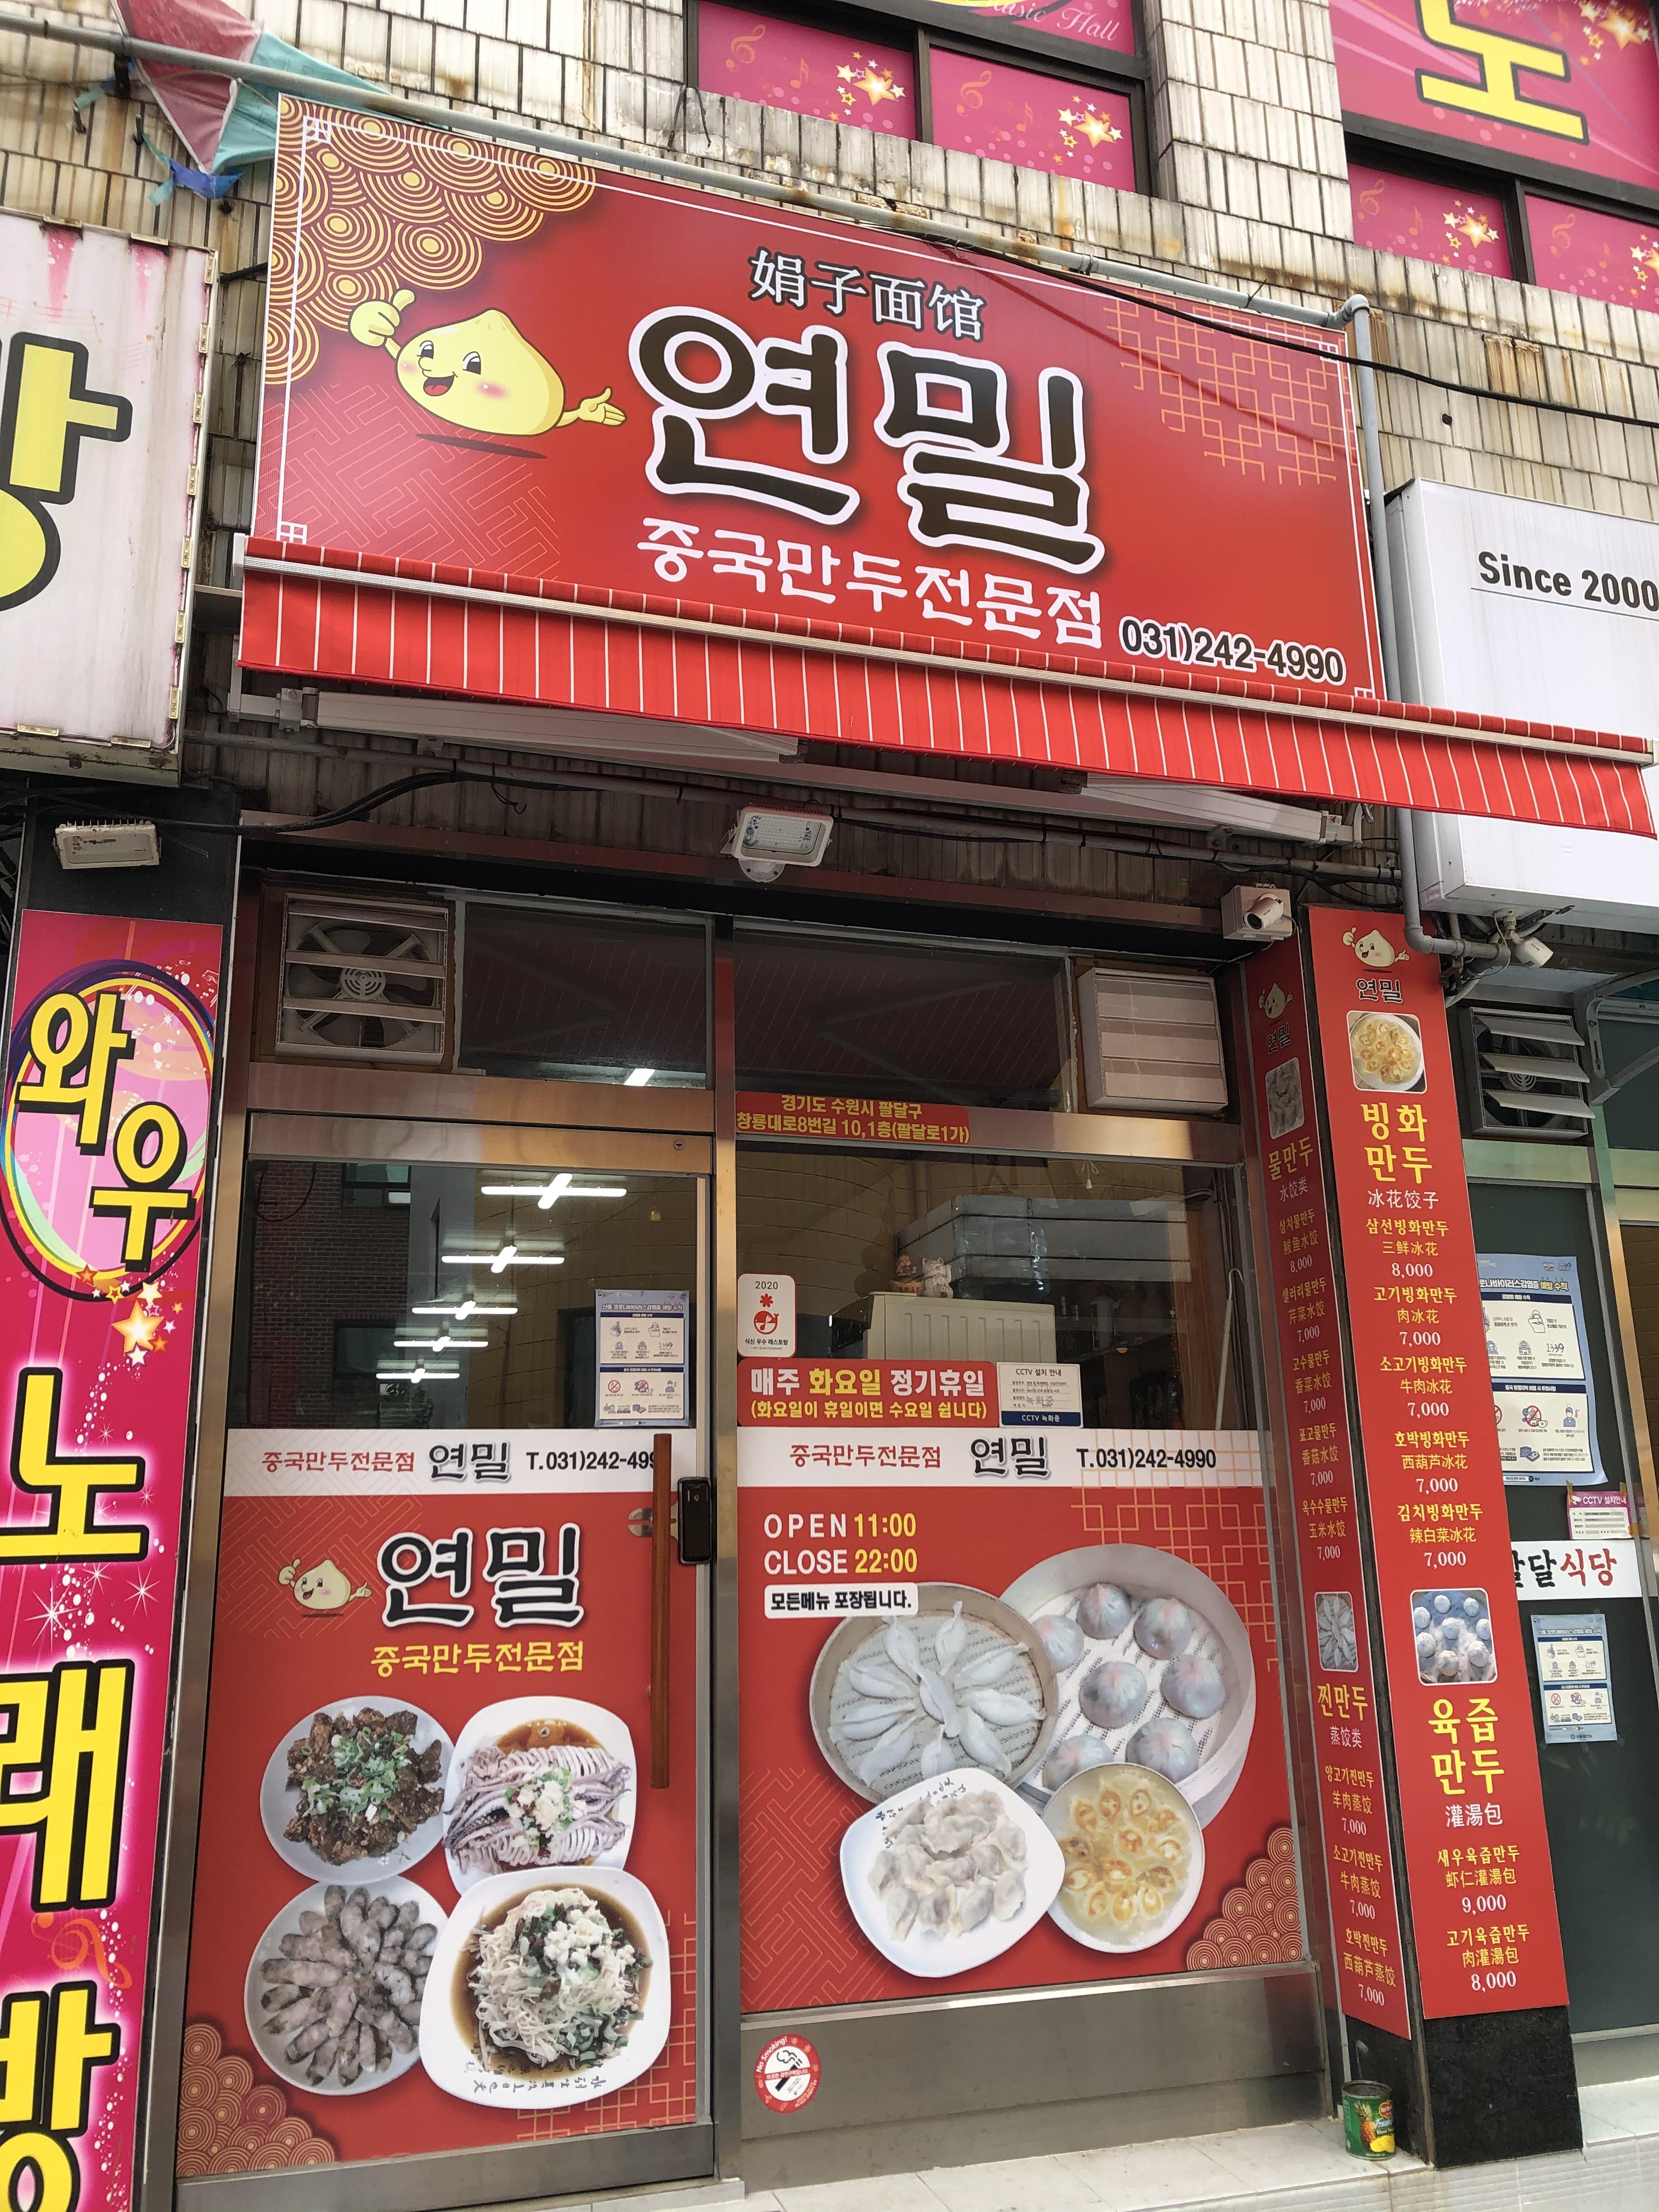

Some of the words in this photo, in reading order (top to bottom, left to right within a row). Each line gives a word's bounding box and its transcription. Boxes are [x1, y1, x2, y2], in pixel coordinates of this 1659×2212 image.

[1056, 8, 1120, 41] Hall
[749, 248, 985, 341] 娟子面馆
[628, 306, 1104, 574] 연밀
[637, 517, 1103, 650] 중국만두전문점
[1478, 550, 1571, 597] Since
[1582, 569, 1659, 613] 2000
[1118, 615, 1346, 686] 031)242-4990
[1356, 978, 1403, 1004] 연밀
[1266, 1023, 1291, 1054] 연밀
[781, 1094, 826, 1114] 경기도
[831, 1098, 874, 1117] 수원시
[878, 1101, 923, 1119] 팔달구
[15, 991, 195, 1272] 와우
[737, 1111, 837, 1135] 창룡대로8번길
[1361, 1102, 1428, 1143] 빙화
[1268, 1136, 1313, 1181] 물만두
[1364, 1144, 1432, 1184] 만두
[1279, 1176, 1308, 1203] 水饺类
[1367, 1188, 1439, 1210] 冰花饺子
[1279, 1209, 1316, 1235] 삼치물만두
[1365, 1218, 1449, 1237] 삼선빙화만두
[1382, 1240, 1439, 1257] 三鲜冰花
[1290, 1255, 1312, 1273] 8,000
[1391, 1262, 1434, 1279] 8,000
[755, 1281, 778, 1290] 2020
[1373, 1286, 1458, 1305] 고기빙화만두
[1288, 1300, 1325, 1325] 芹菜水饺
[1397, 1308, 1440, 1324] 肉冰花
[1297, 1325, 1320, 1344] 7,000
[1400, 1331, 1441, 1348] 7,000
[1547, 1343, 1565, 1353] 1339
[1293, 1349, 1330, 1371] 고수물만두
[1379, 1356, 1468, 1374] 소고기빙화만두
[751, 1368, 800, 1396] 매주
[809, 1368, 881, 1397] 화요일
[890, 1369, 985, 1397] 정기휴일
[1295, 1372, 1331, 1395] 香菜水饺
[1400, 1378, 1453, 1395] 牛肉冰花
[751, 1400, 818, 1419] (화요일이
[823, 1400, 883, 1419] 휴일이면
[889, 1400, 933, 1419] 수요일
[937, 1400, 988, 1420] 쉽니다)
[1304, 1397, 1326, 1414] 7,000
[1407, 1402, 1449, 1419] 7,000
[1041, 1414, 1060, 1423] 녹화중
[1299, 1422, 1337, 1442] 표고물만두
[1394, 1431, 1470, 1448] 호박빙화만두
[261, 1450, 415, 1474] 중국만두전문점
[428, 1441, 511, 1483] 연밀
[789, 1443, 942, 1470] 중국만두전문점
[969, 1436, 1053, 1480] 연밀
[1075, 1447, 1217, 1471] T.031)242-4990
[1401, 1454, 1469, 1470] 西葫芦冰花
[1310, 1470, 1334, 1487] 7,000
[1416, 1477, 1458, 1495] 7,000
[1302, 1496, 1348, 1516] 옥수수물만두
[1583, 1496, 1602, 1504] CCTV
[1397, 1503, 1483, 1522] 김치빙화만두
[764, 1513, 848, 1538] OPEN
[854, 1512, 917, 1537] 11:00
[1308, 1520, 1346, 1538] 玉米水饺
[1409, 1526, 1476, 1544] 辣白菜冰花
[764, 1549, 849, 1576] CLOSE
[854, 1548, 918, 1573] 22:00
[1317, 1545, 1341, 1561] 7,000
[1424, 1551, 1466, 1569] 7,000
[376, 1522, 585, 1629] 연밀
[770, 1589, 831, 1611] 모든메뉴
[834, 1588, 912, 1611] 포장됩니다.
[370, 1640, 584, 1678] 중국만두전문점
[1317, 1683, 1368, 1721] 찐만두
[1427, 1698, 1499, 1745] 육즙
[1329, 1725, 1363, 1748] 蒸饺类
[1325, 1764, 1375, 1790] 양고기찐만두
[1431, 1749, 1505, 1795] 만두
[1332, 1790, 1373, 1815] 羊肉蒸饺
[1341, 1817, 1367, 1836] 7,000
[1333, 1844, 1384, 1873] 소고기찐만두
[1437, 1844, 1520, 1867] 새우육즙만두
[1340, 1870, 1381, 1899] 牛肉蒸饺
[1350, 1899, 1375, 1920] 7,000
[1462, 1894, 1506, 1916] 9,000
[1345, 1927, 1388, 1957] 호박찐만두
[1446, 1923, 1530, 1947] 고기육즙만두
[1343, 1951, 1396, 1988] 西葫芦蒸饺
[1471, 1971, 1516, 1993] 8,000
[1358, 1983, 1385, 2006] 7,000
[755, 2062, 764, 2073] No
